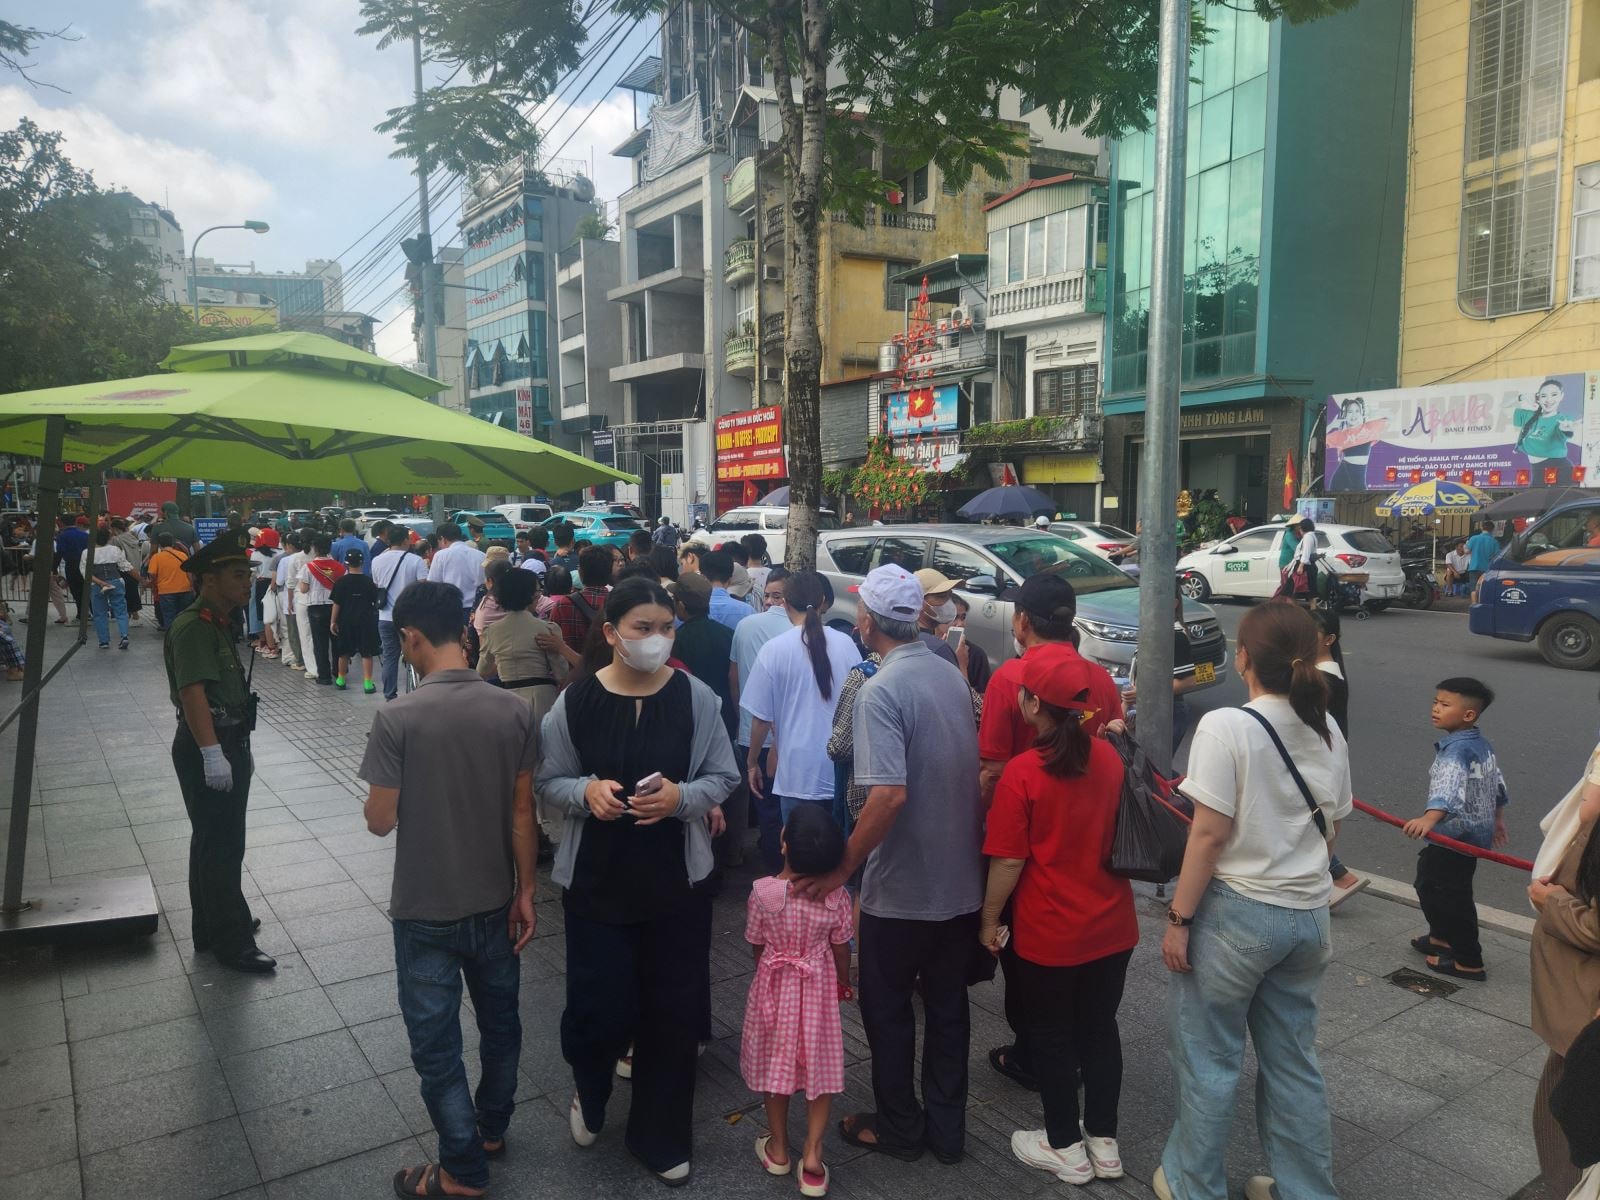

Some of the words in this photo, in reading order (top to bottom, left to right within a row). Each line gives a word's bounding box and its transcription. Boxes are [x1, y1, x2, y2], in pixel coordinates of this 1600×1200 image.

[1180, 413, 1202, 427] NHH
[1206, 410, 1235, 425] TÙNG
[519, 419, 531, 429] 46
[1437, 490, 1470, 505] be
[1400, 506, 1426, 516] 50K
[1227, 561, 1247, 569] Grab
